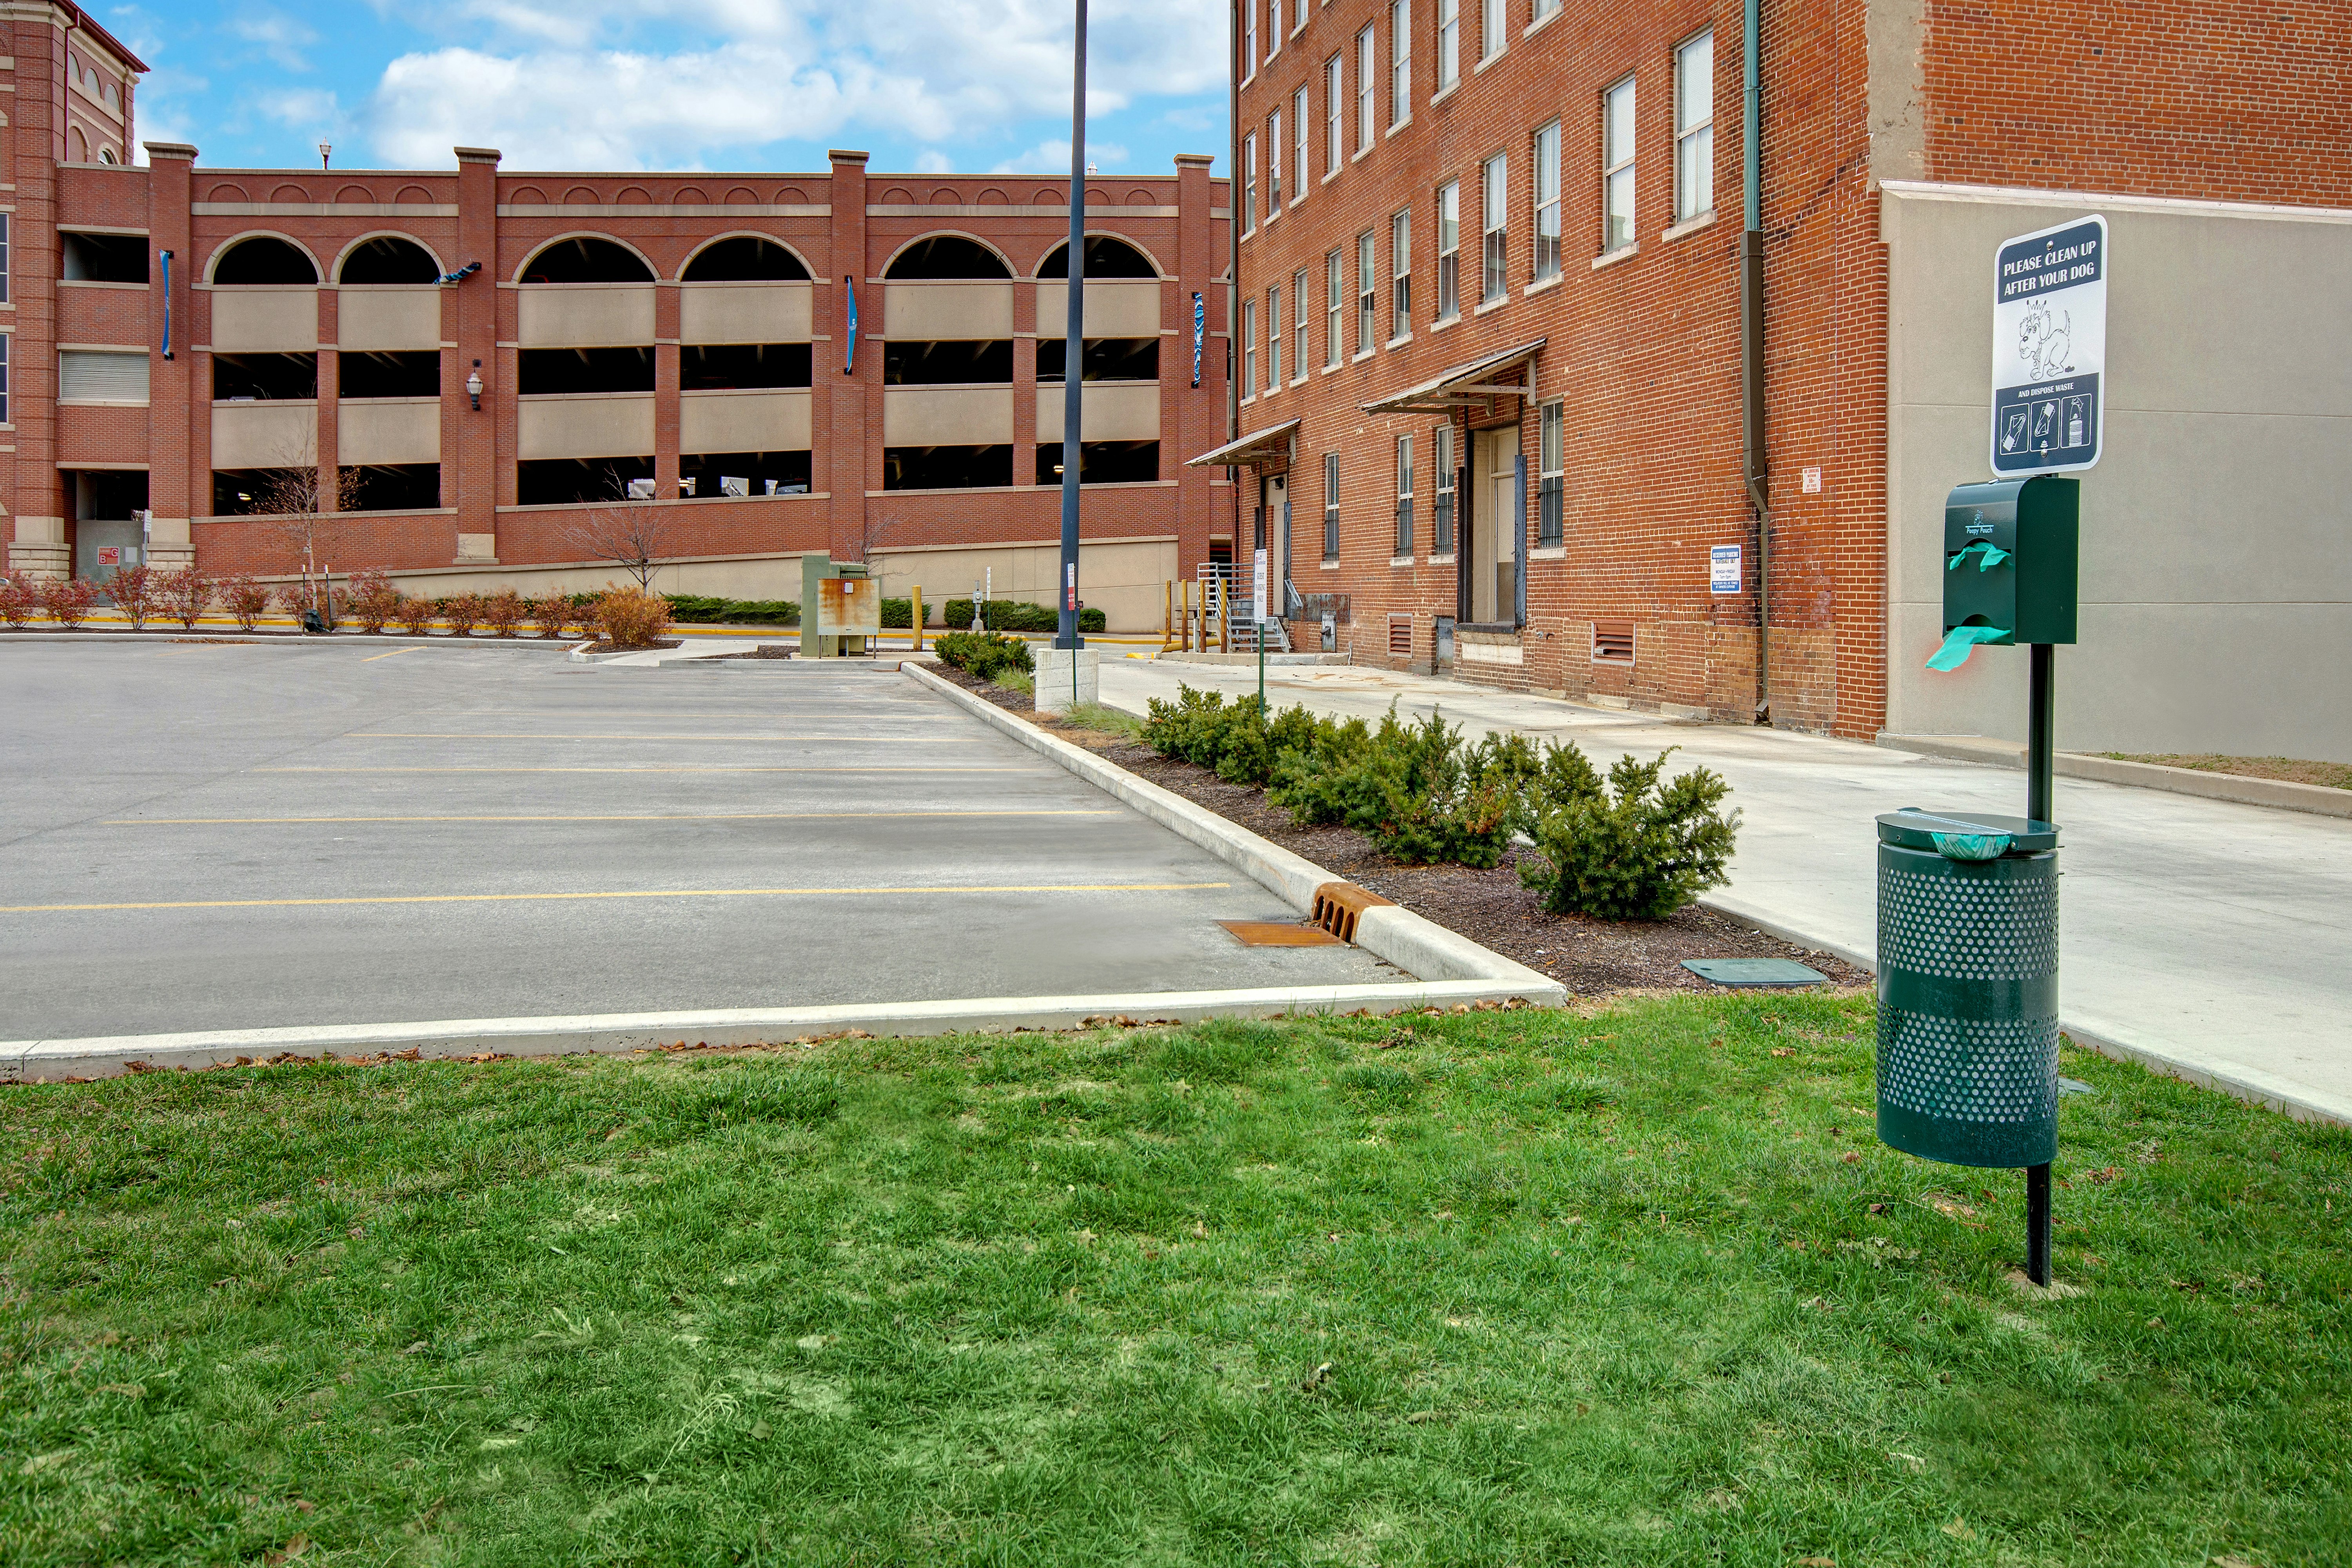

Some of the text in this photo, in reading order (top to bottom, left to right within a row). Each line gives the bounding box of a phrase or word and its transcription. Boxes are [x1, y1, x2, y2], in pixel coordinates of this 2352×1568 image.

[2004, 241, 2096, 277] PLEASE CLEAN UP
[2004, 262, 2094, 296] AFTER YOUR DOG
[2031, 385, 2054, 396] DISPOSE
[2055, 382, 2074, 392] WASTE
[1966, 527, 1979, 535] Poopy
[111, 548, 118, 557] G
[100, 555, 106, 563] B
